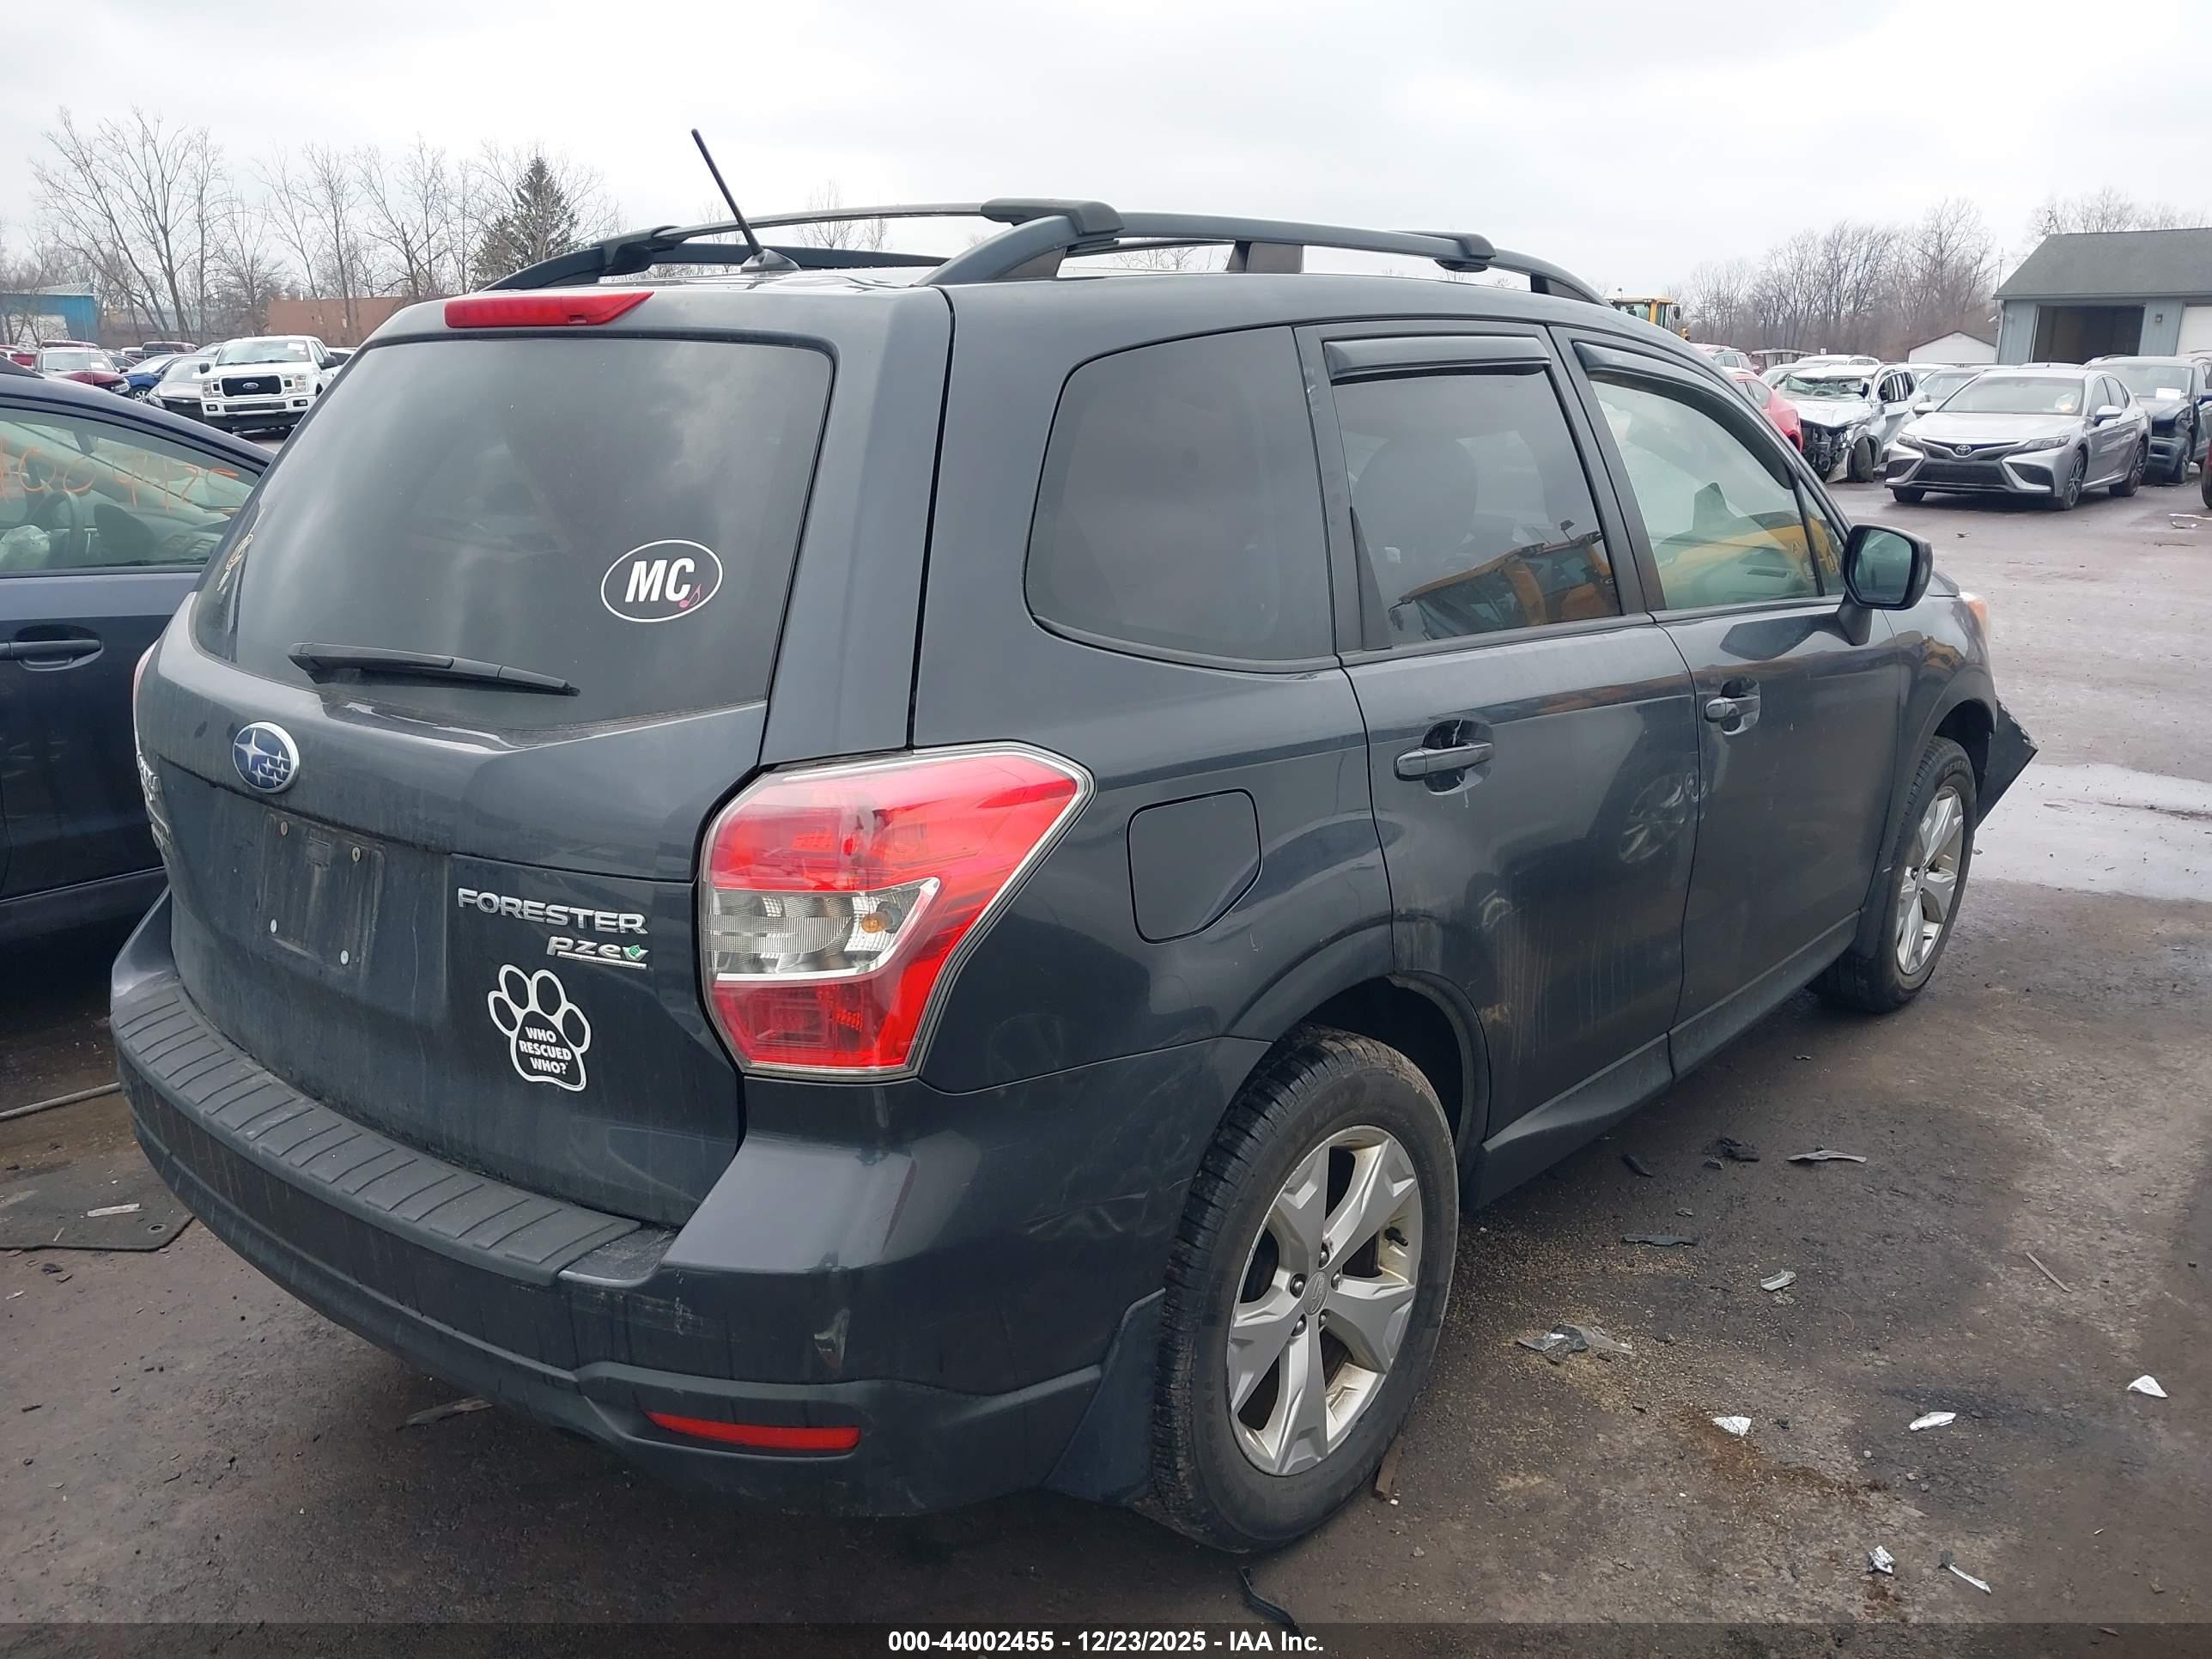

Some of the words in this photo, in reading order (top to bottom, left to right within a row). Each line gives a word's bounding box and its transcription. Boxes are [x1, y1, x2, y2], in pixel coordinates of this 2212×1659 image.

[624, 557, 696, 603] MC
[458, 888, 649, 934] FORESTER
[525, 1026, 557, 1043] WHO
[518, 1040, 573, 1060] RESCUED
[530, 1057, 568, 1075] WHO?
